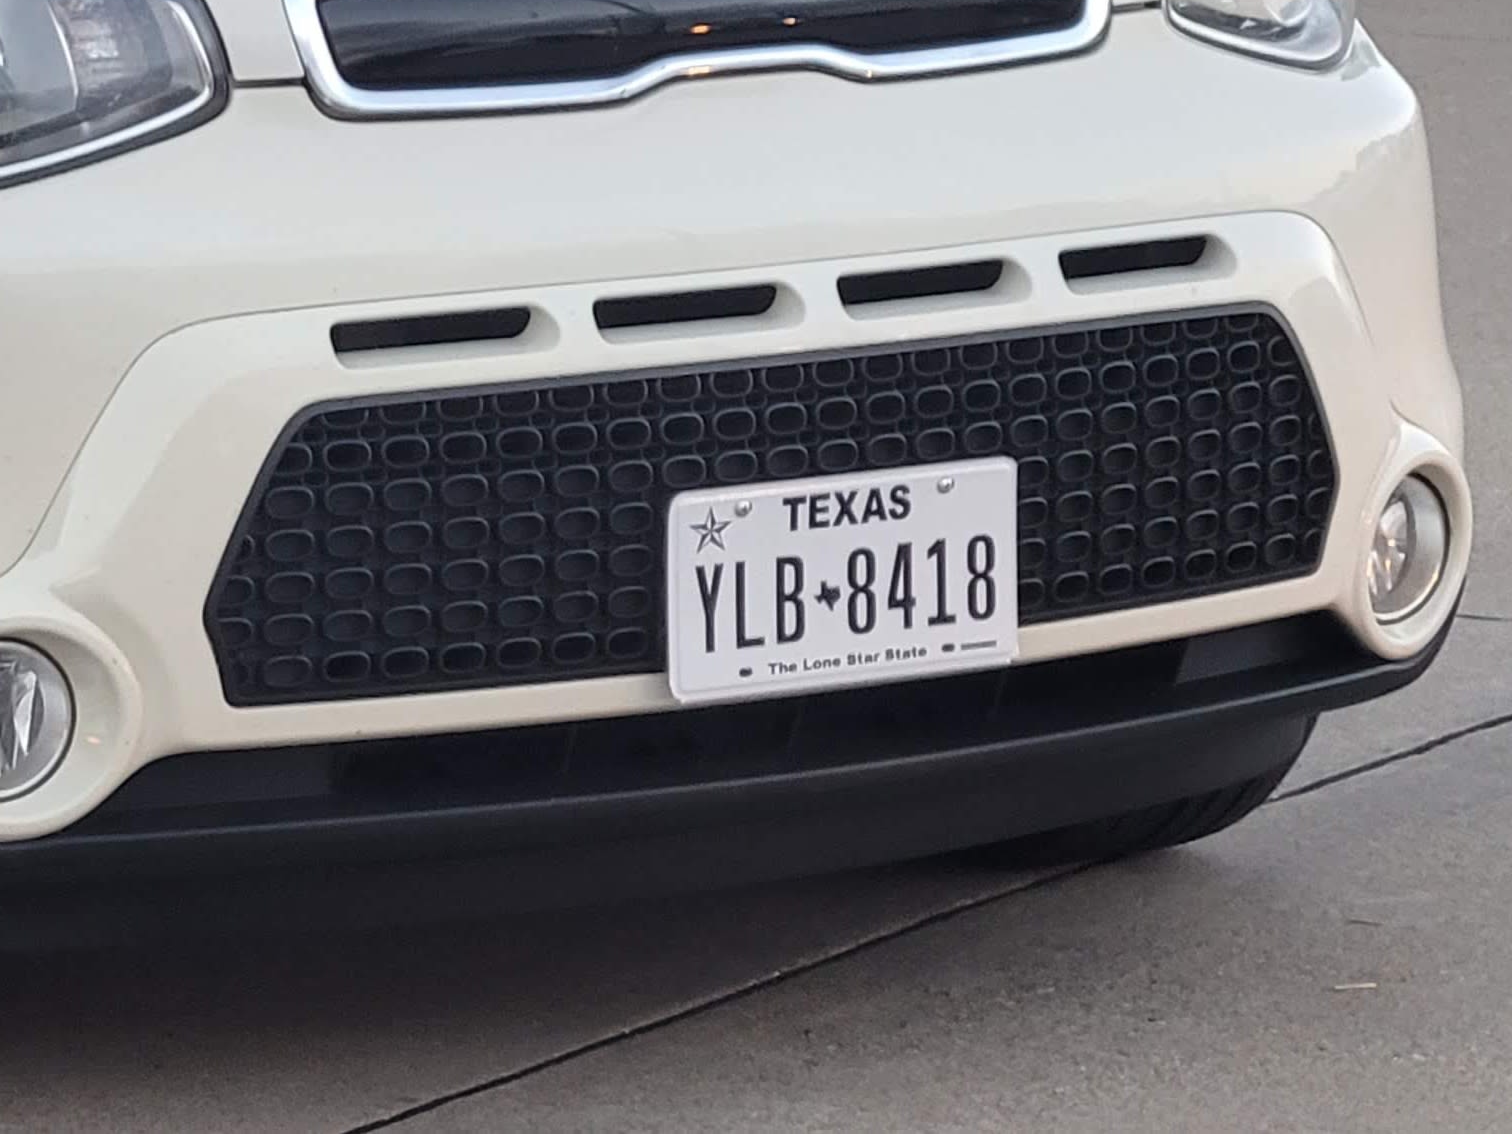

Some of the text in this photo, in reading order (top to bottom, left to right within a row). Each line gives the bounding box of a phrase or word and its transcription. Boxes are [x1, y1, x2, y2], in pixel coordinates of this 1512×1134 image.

[783, 484, 912, 532] TEXAS
[768, 646, 928, 676] The Lone Star State
